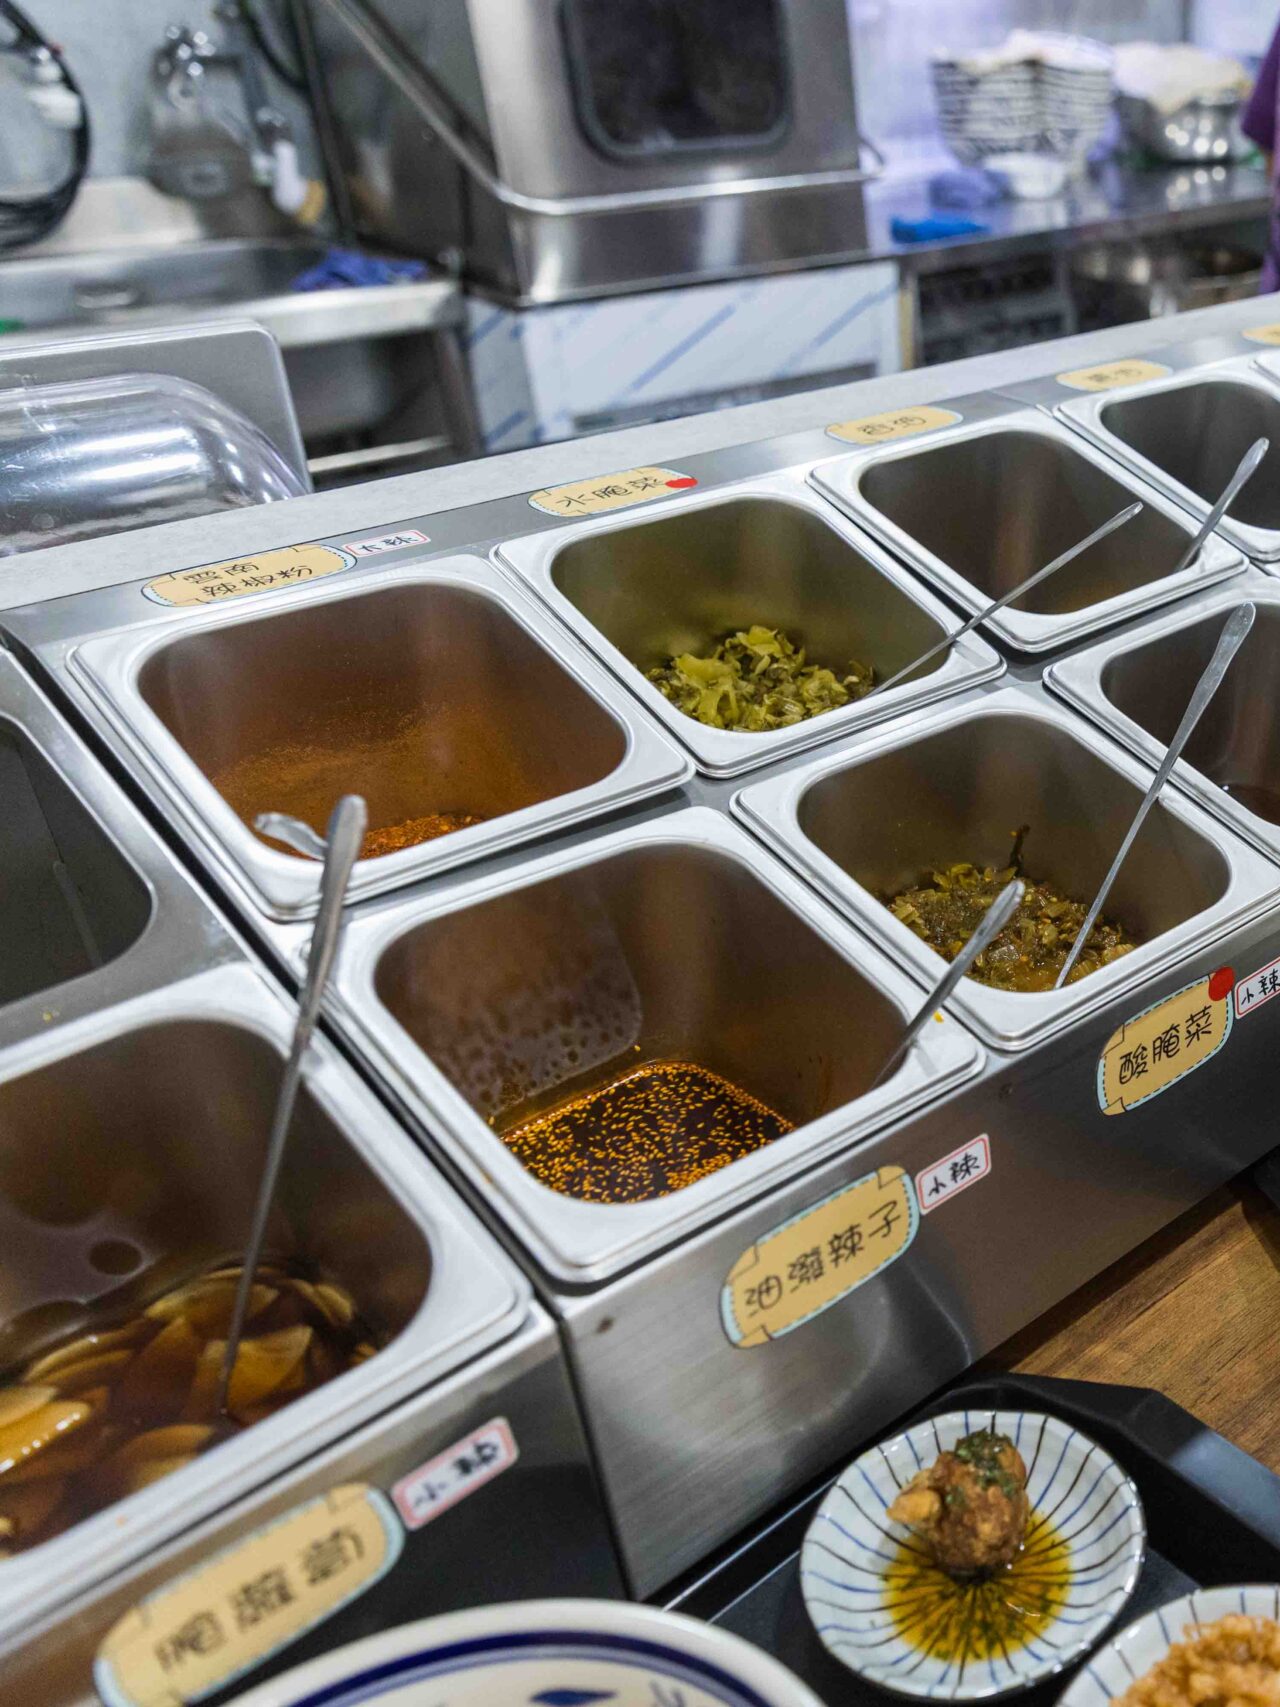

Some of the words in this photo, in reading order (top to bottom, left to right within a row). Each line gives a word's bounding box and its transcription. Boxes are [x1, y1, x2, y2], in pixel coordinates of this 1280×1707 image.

[202, 565, 312, 597] 辣椒粉
[928, 1152, 982, 1198] 小辣
